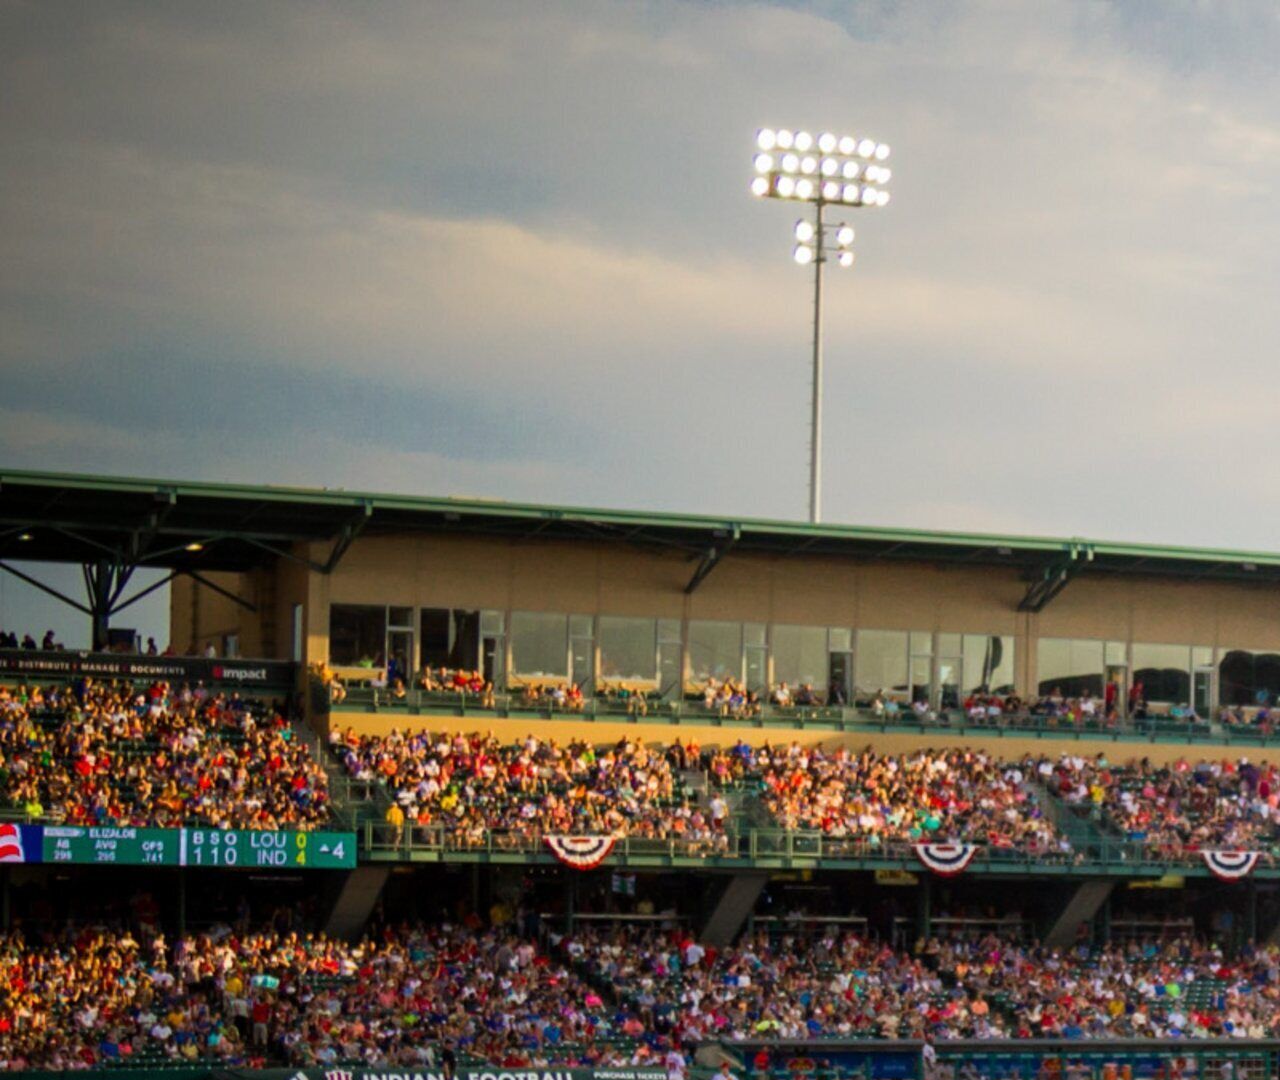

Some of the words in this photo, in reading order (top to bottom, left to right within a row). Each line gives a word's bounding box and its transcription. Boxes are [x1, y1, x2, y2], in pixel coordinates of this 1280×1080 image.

[81, 663, 120, 673] MANAGE
[130, 665, 186, 675] DOCUMENTS
[193, 832, 204, 845] B
[210, 832, 220, 845] S
[250, 832, 287, 848] LOU
[295, 832, 307, 848] 0
[193, 847, 202, 864] 1
[210, 847, 219, 864] 1
[224, 847, 237, 865] 0
[257, 850, 287, 865] IND
[296, 851, 306, 865] 4
[332, 841, 345, 859] 4
